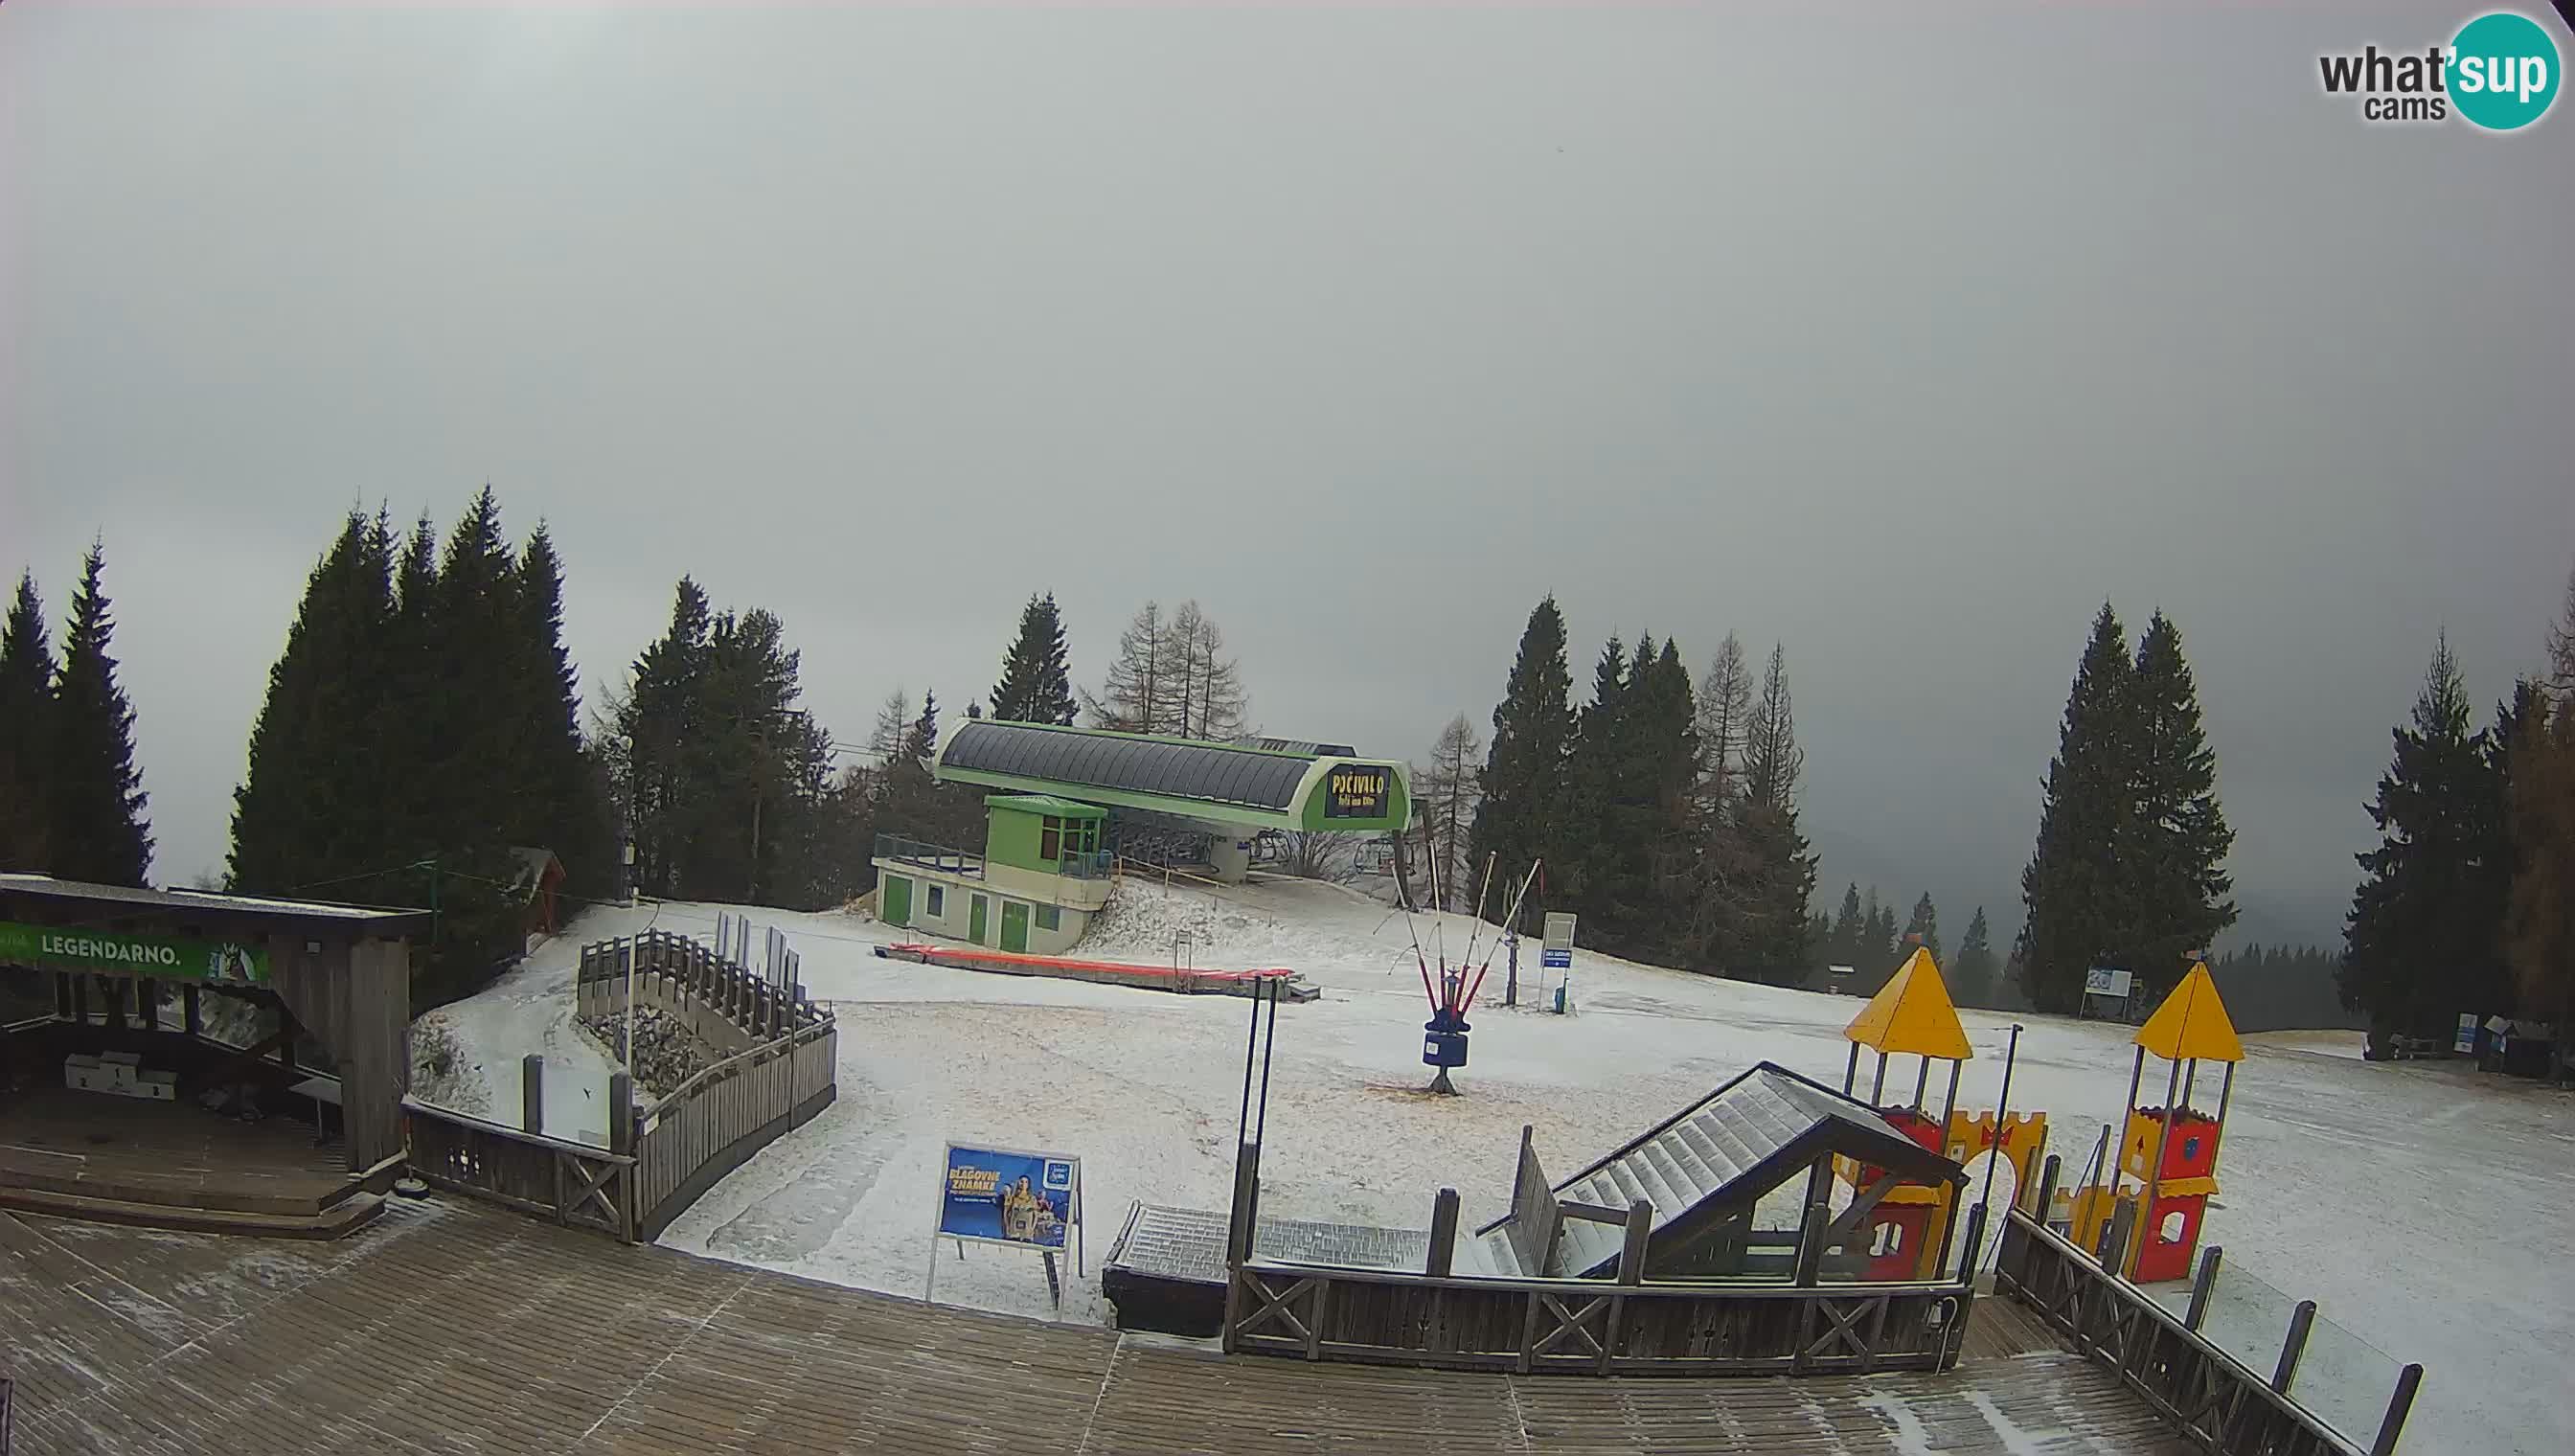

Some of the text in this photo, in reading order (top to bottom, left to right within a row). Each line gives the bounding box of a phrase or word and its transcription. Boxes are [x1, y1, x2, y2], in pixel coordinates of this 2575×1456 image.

[42, 935, 181, 966] LEGENDARNO.
[949, 1168, 1001, 1181] BLAGOVNE
[951, 1179, 996, 1191] ZNAMKE
